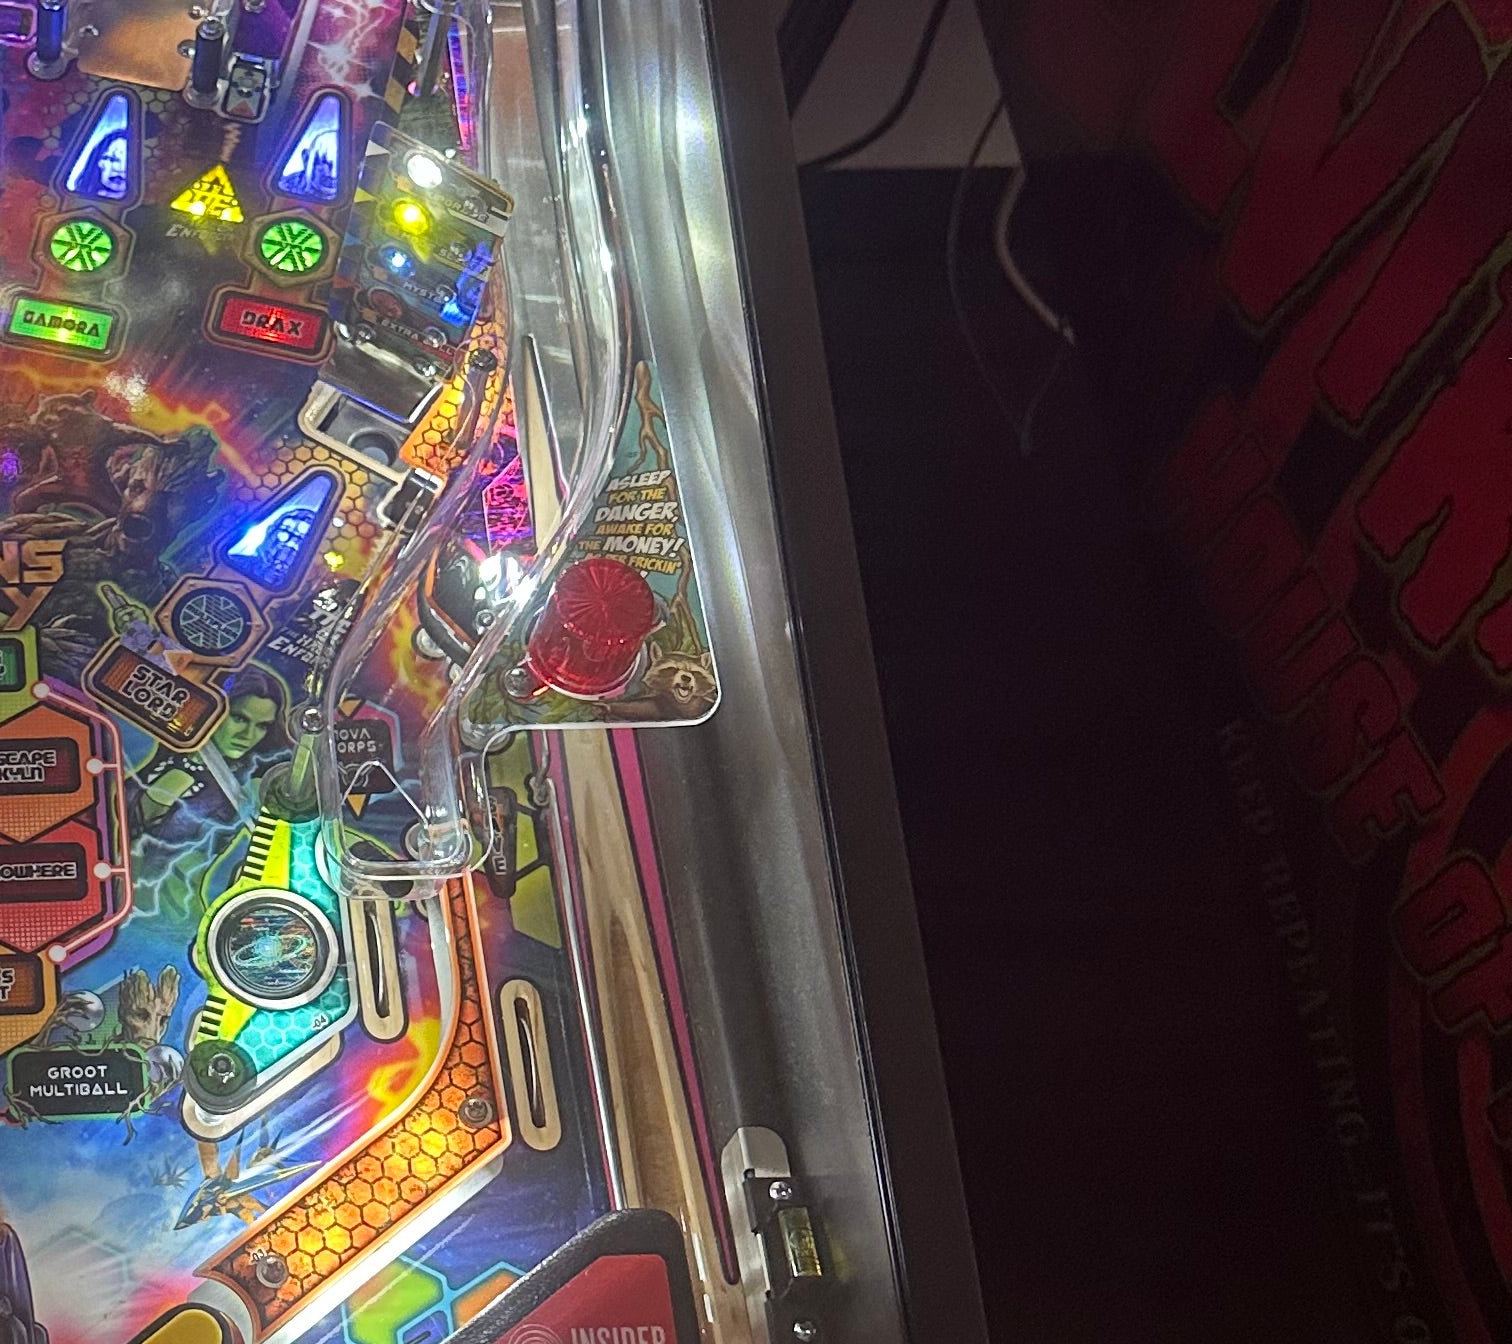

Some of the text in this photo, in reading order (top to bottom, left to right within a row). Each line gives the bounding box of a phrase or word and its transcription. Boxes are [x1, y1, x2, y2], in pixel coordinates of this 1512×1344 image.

[22, 310, 102, 338] GAMORA
[242, 309, 303, 336] DRAX
[605, 469, 672, 492] ASLEEP
[608, 487, 667, 504] FOR THE
[595, 522, 674, 536] AWAKE FOR
[602, 535, 686, 558] MONEY!
[130, 664, 190, 708] STAR
[118, 680, 179, 722] LORD
[46, 1064, 109, 1081] GROOT
[29, 1081, 129, 1098] MULTIBALL
